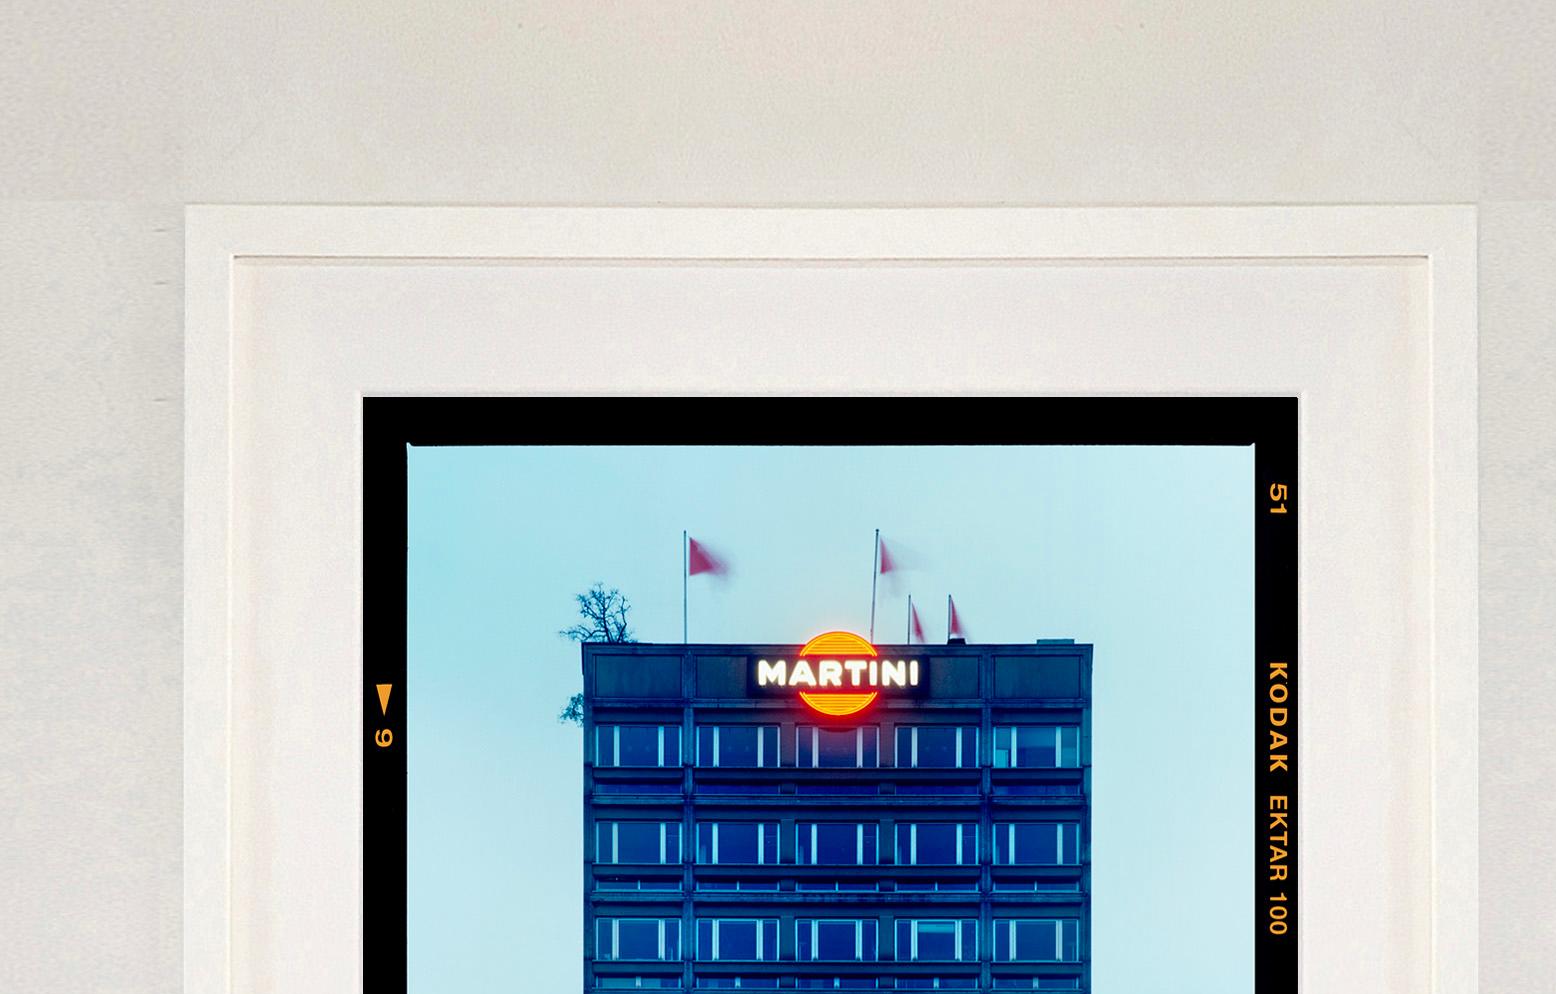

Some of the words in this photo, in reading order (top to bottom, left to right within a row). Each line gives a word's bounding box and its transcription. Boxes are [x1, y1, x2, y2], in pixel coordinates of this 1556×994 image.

[1269, 482, 1289, 514] 51
[757, 659, 920, 687] MARTINI
[1269, 662, 1289, 772] KODAK
[1269, 795, 1289, 881] EKTAR
[1269, 892, 1288, 935] 100
